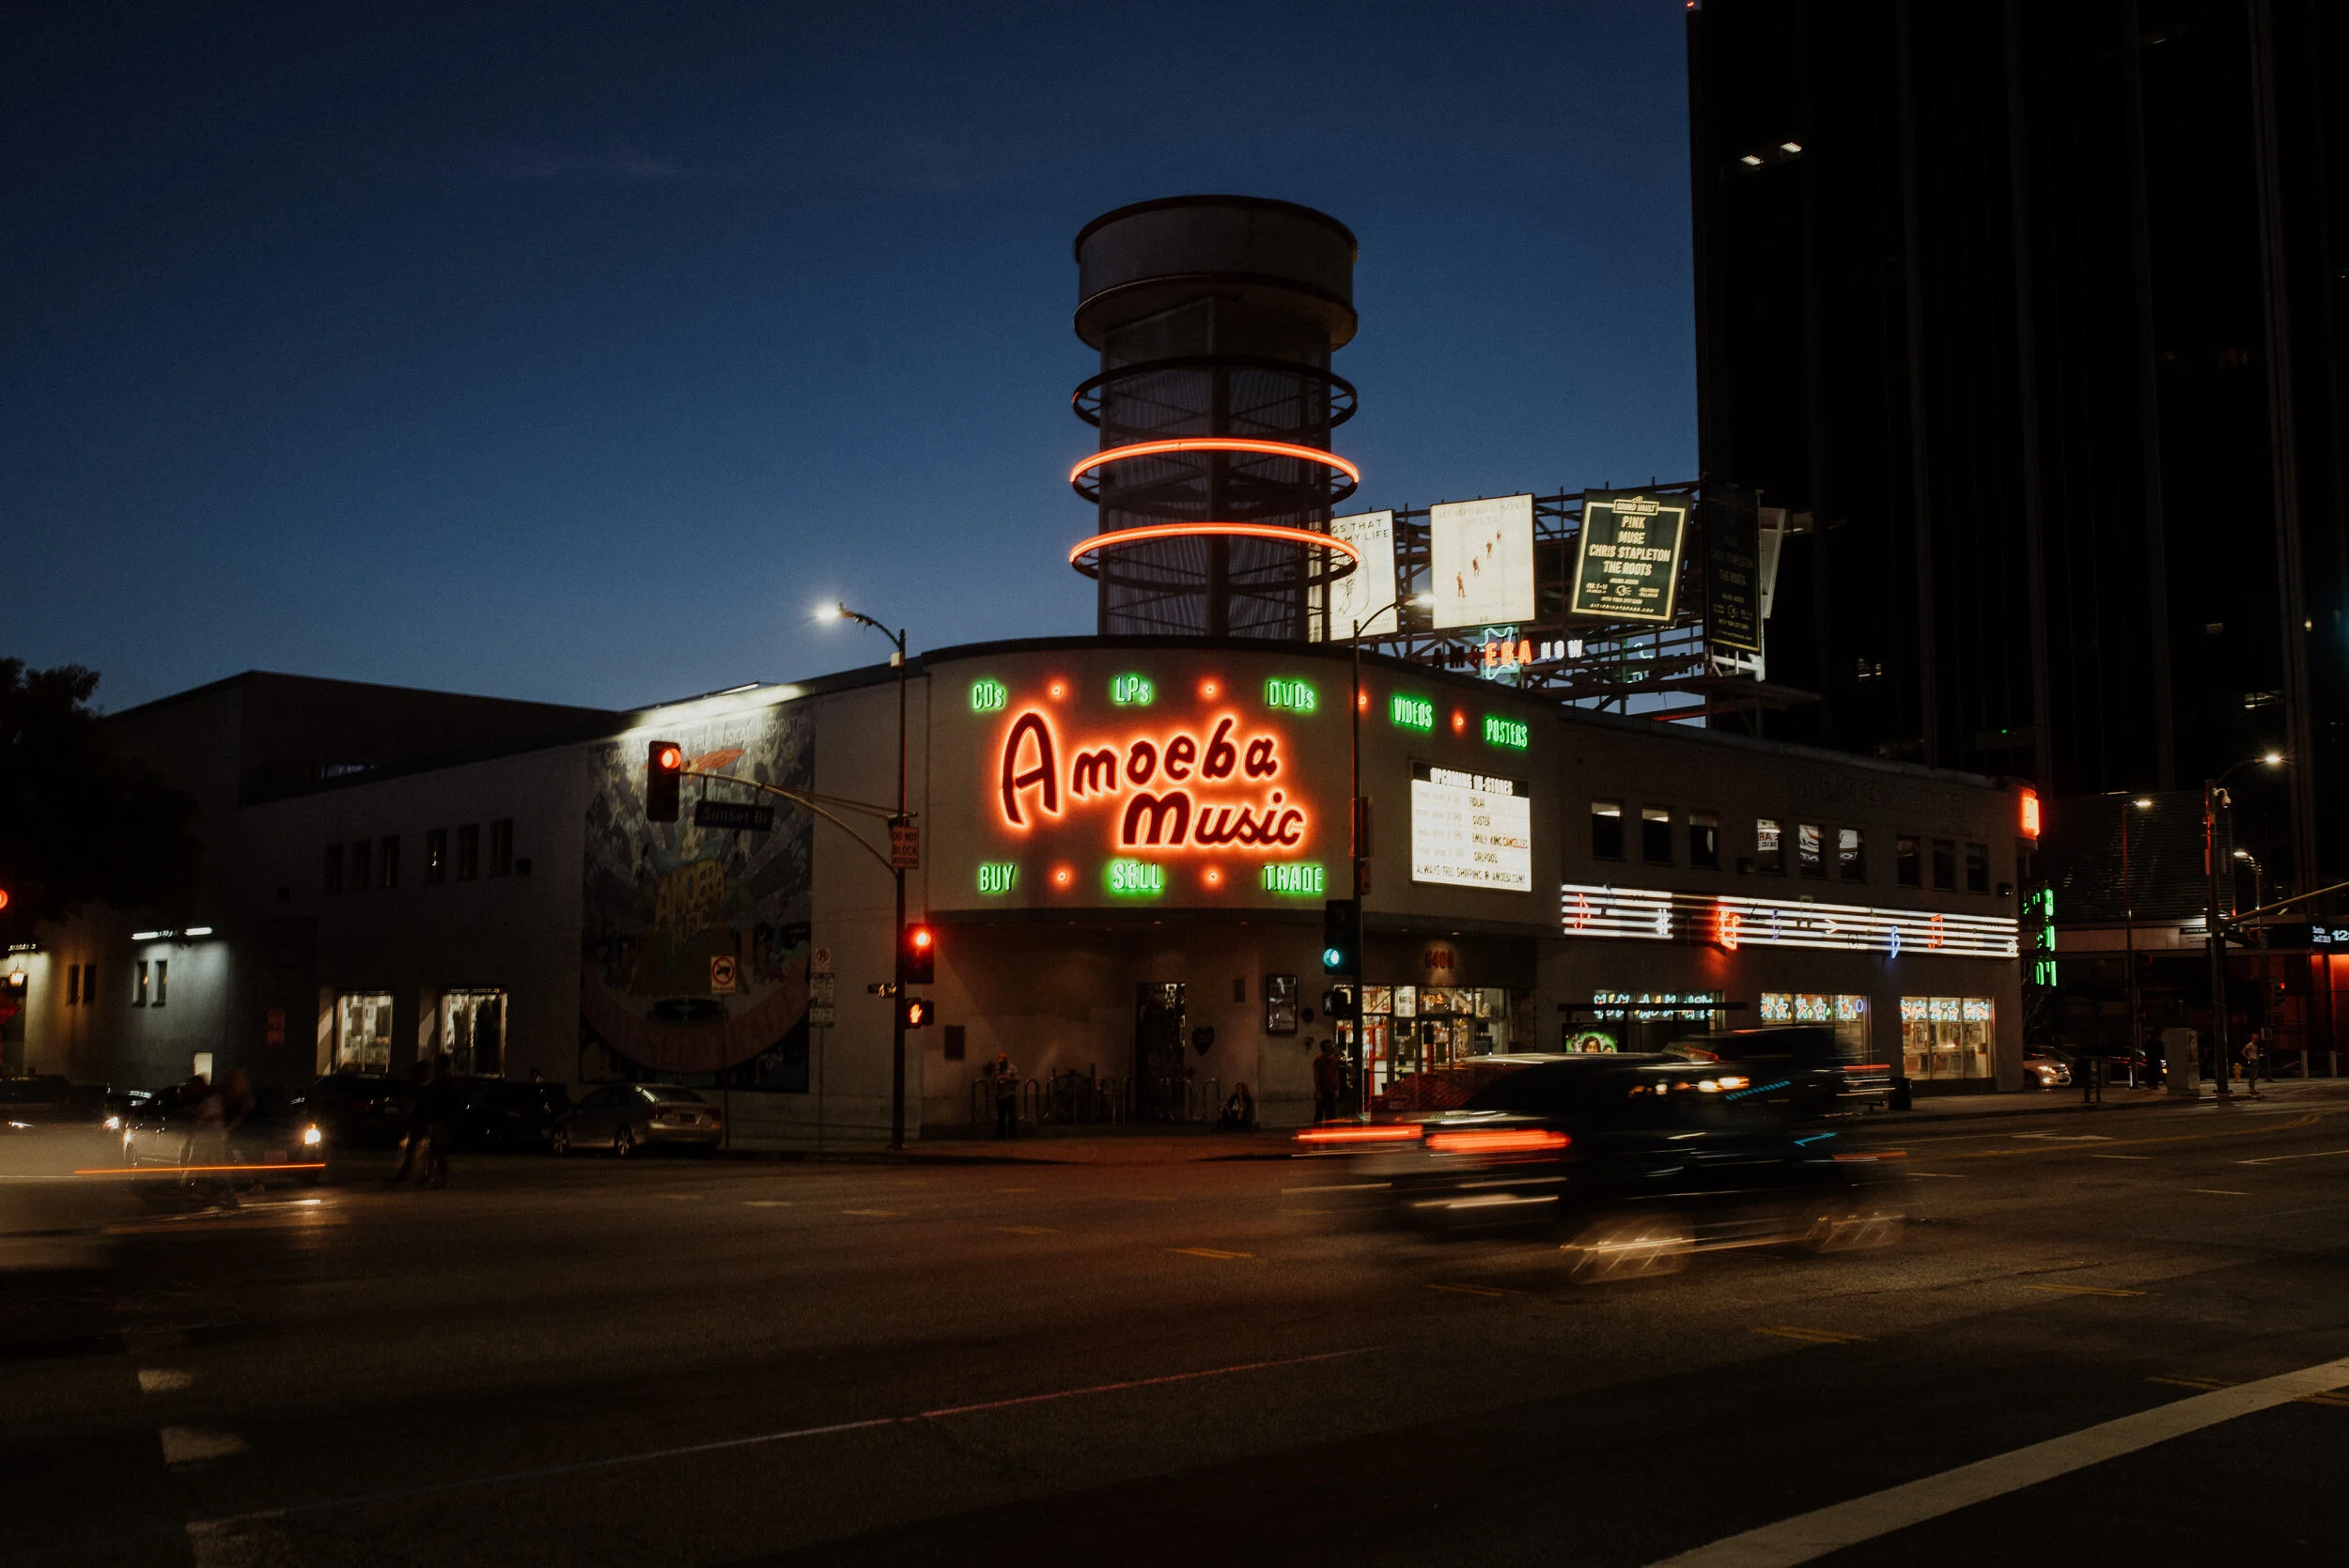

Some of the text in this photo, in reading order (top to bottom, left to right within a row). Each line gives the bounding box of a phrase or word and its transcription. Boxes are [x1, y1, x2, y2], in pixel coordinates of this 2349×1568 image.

[1616, 502, 1637, 512] SOUND
[1350, 519, 1383, 532] THAT
[1365, 530, 1389, 541] LIFE
[1618, 530, 1646, 544] MUSE
[1588, 544, 1671, 562] CHRIS STAPLETON
[1603, 560, 1652, 577] THE ROOTS
[972, 683, 1003, 710] CDs
[1114, 676, 1150, 703] LPs
[1267, 681, 1315, 710] DVDs
[1392, 697, 1432, 728] VIDEOS
[1486, 718, 1528, 748] POSTERS
[1001, 709, 1281, 827] Amoeba
[702, 806, 748, 824] Sunset
[1118, 788, 1307, 849] Music
[893, 846, 917, 855] BLOCK
[905, 832, 917, 842] NOT
[979, 864, 1016, 893] BUY
[1112, 862, 1161, 891] SELL
[1263, 865, 1323, 893] TRADE
[652, 858, 725, 934] AMOEBA
